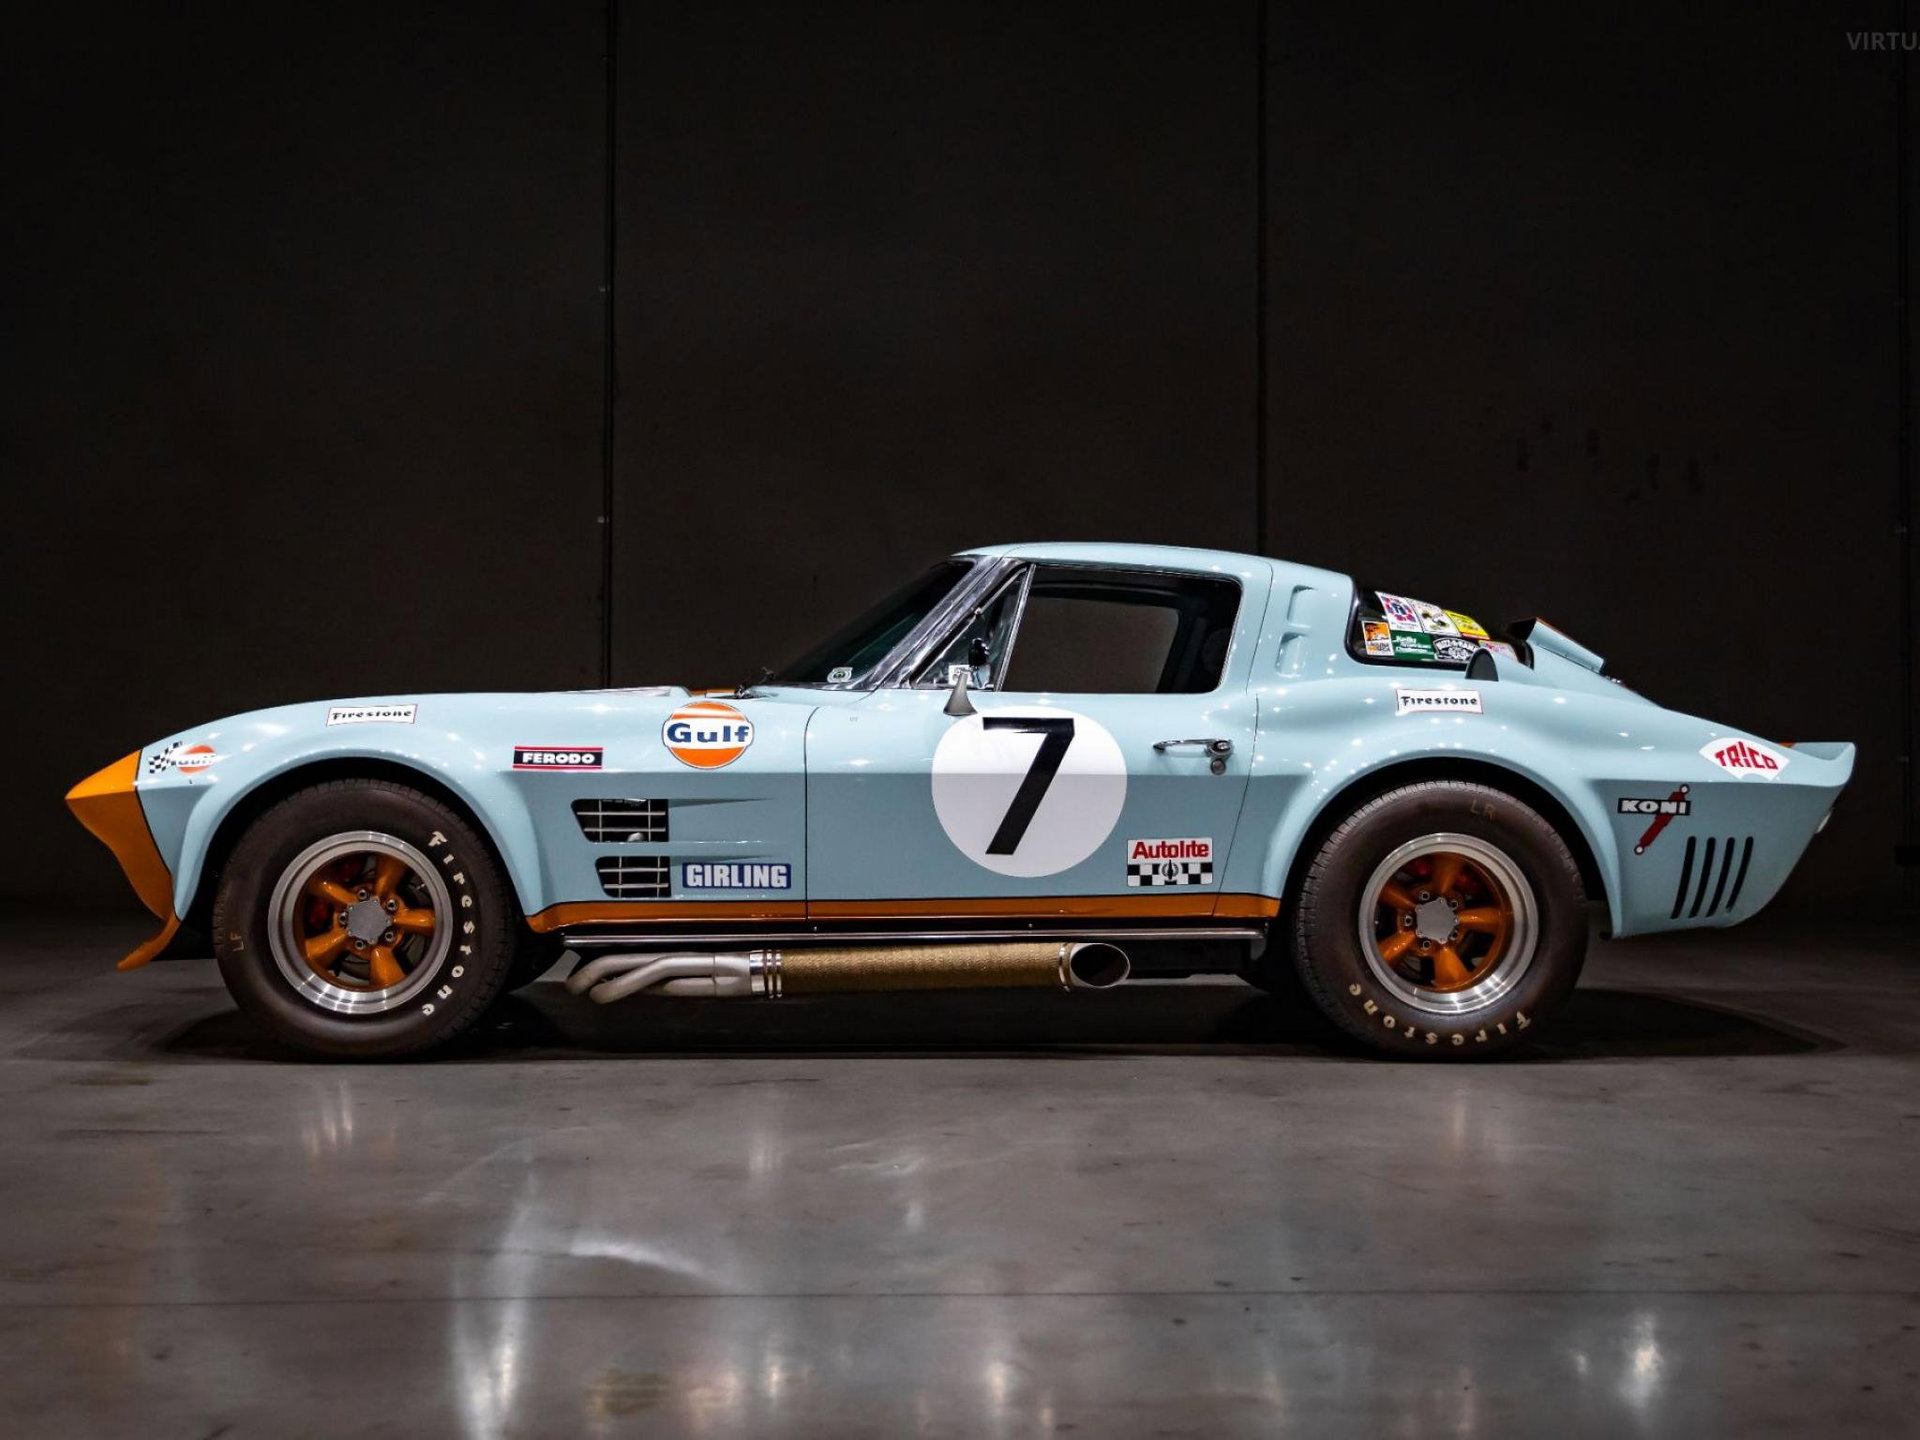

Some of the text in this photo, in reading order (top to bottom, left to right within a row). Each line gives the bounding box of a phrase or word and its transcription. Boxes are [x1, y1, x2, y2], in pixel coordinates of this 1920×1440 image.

[1401, 696, 1478, 706] Firestone
[332, 710, 412, 720] Firestone
[667, 722, 750, 743] Gulf
[523, 752, 595, 764] FERODO
[1714, 741, 1779, 770] TRICO
[983, 717, 1075, 855] 7
[1621, 800, 1687, 814] KONI
[1132, 840, 1210, 859] Autolite
[687, 865, 788, 888] GIRLING
[421, 831, 476, 1016] Firestone
[1349, 983, 1531, 1046] Firestone
